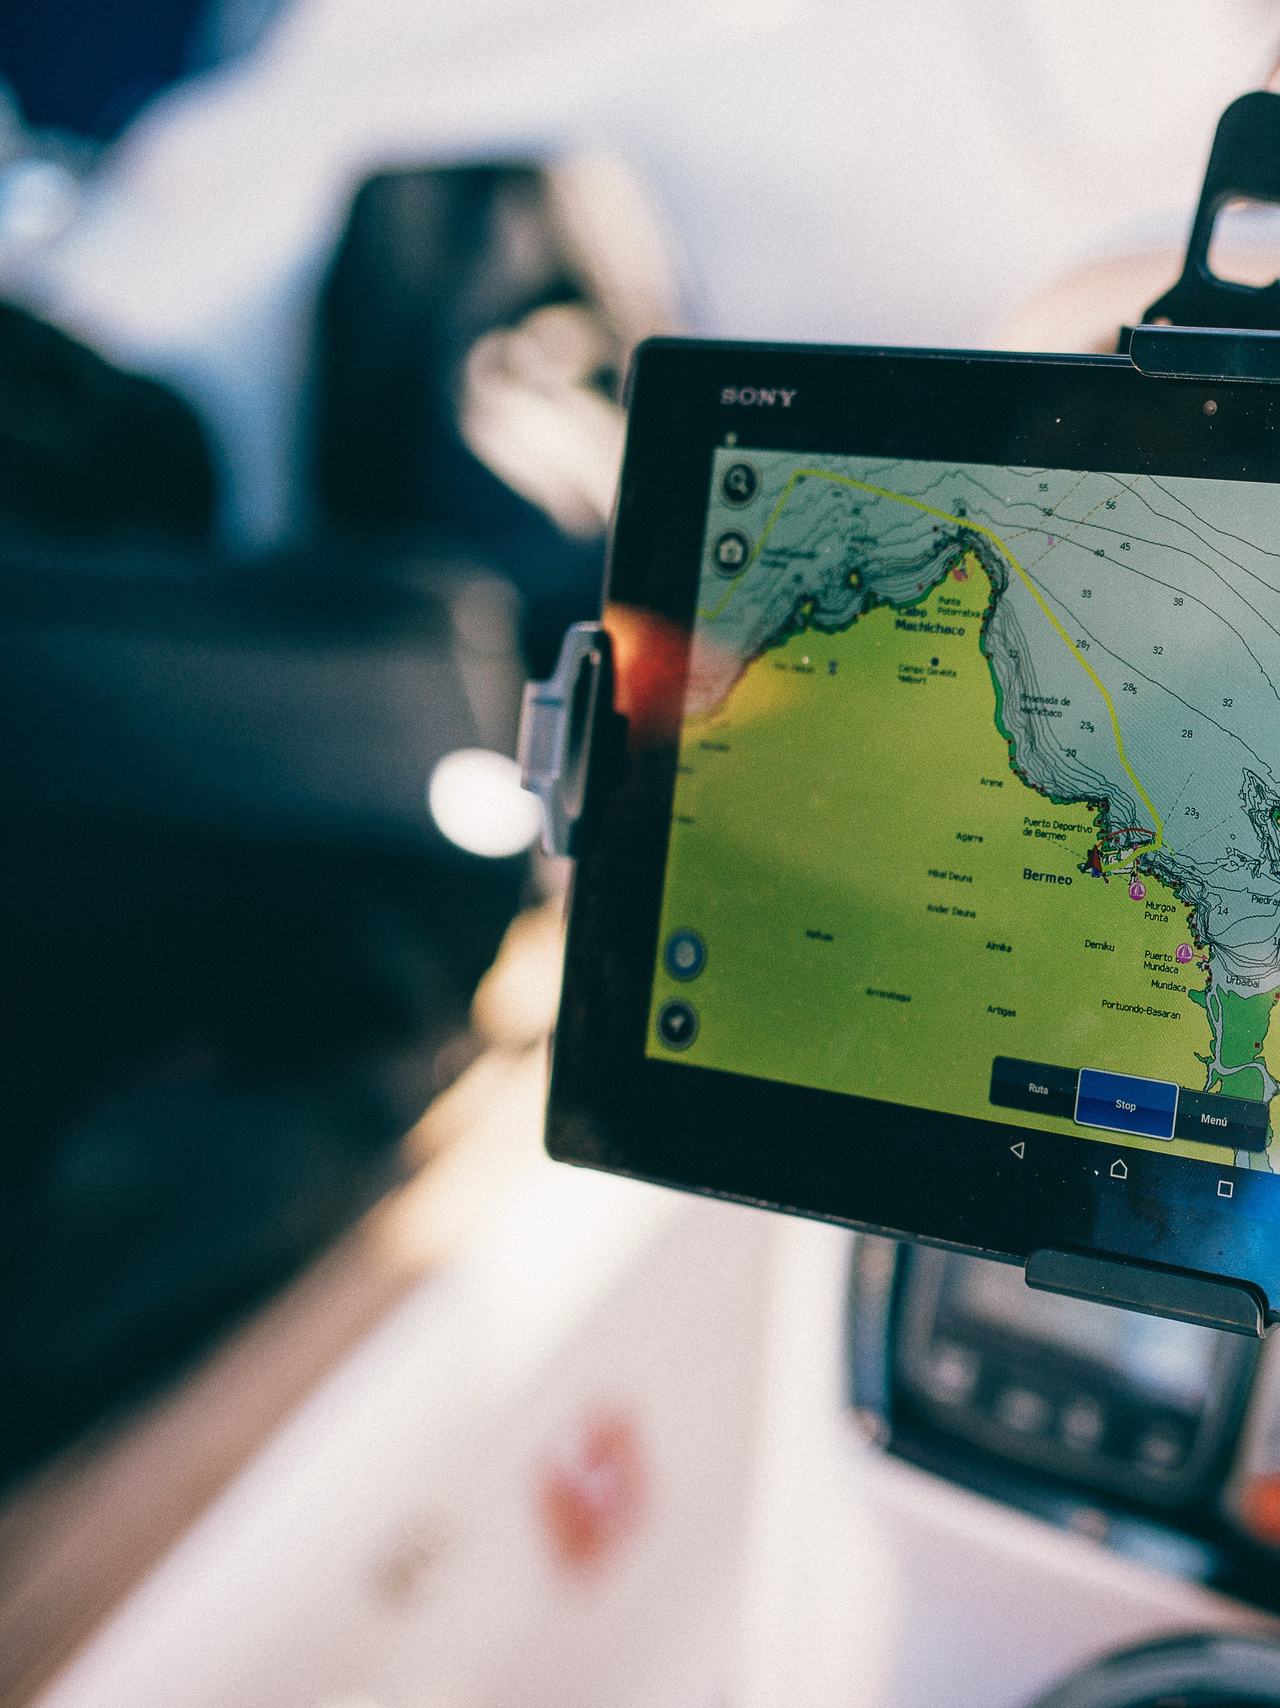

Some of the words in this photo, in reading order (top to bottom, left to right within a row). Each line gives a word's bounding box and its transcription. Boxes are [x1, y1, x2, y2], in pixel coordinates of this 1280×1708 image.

[720, 387, 796, 407] SONY
[1039, 483, 1049, 492] 55
[1105, 501, 1116, 510] 56
[1120, 542, 1131, 551] 45
[1173, 598, 1184, 606] 38
[898, 606, 927, 618] Cabo
[895, 619, 965, 636] Machichaco
[1153, 646, 1163, 655] 32
[1060, 697, 1071, 706] de
[1222, 699, 1233, 707] 32
[1181, 730, 1193, 738] 28
[1065, 748, 1076, 757] 20
[1023, 816, 1050, 829] Puerto
[1053, 821, 1092, 834] Deportivo
[1023, 828, 1033, 837] de
[1035, 829, 1066, 841] Bermeo
[1023, 868, 1072, 885] Bermeo
[1145, 901, 1176, 913] Murgoa
[1218, 906, 1229, 915] 14
[1144, 912, 1168, 923] Punta
[1085, 940, 1115, 952] Demiku
[1144, 951, 1172, 963] Puerto
[1144, 961, 1179, 974] Mundaca
[1151, 980, 1186, 992] Mundaca
[1102, 999, 1181, 1020] Portuondo-Basaran
[1029, 1083, 1049, 1095] Ruta
[1115, 1099, 1137, 1112] Stop
[1201, 1114, 1228, 1127] Menú
